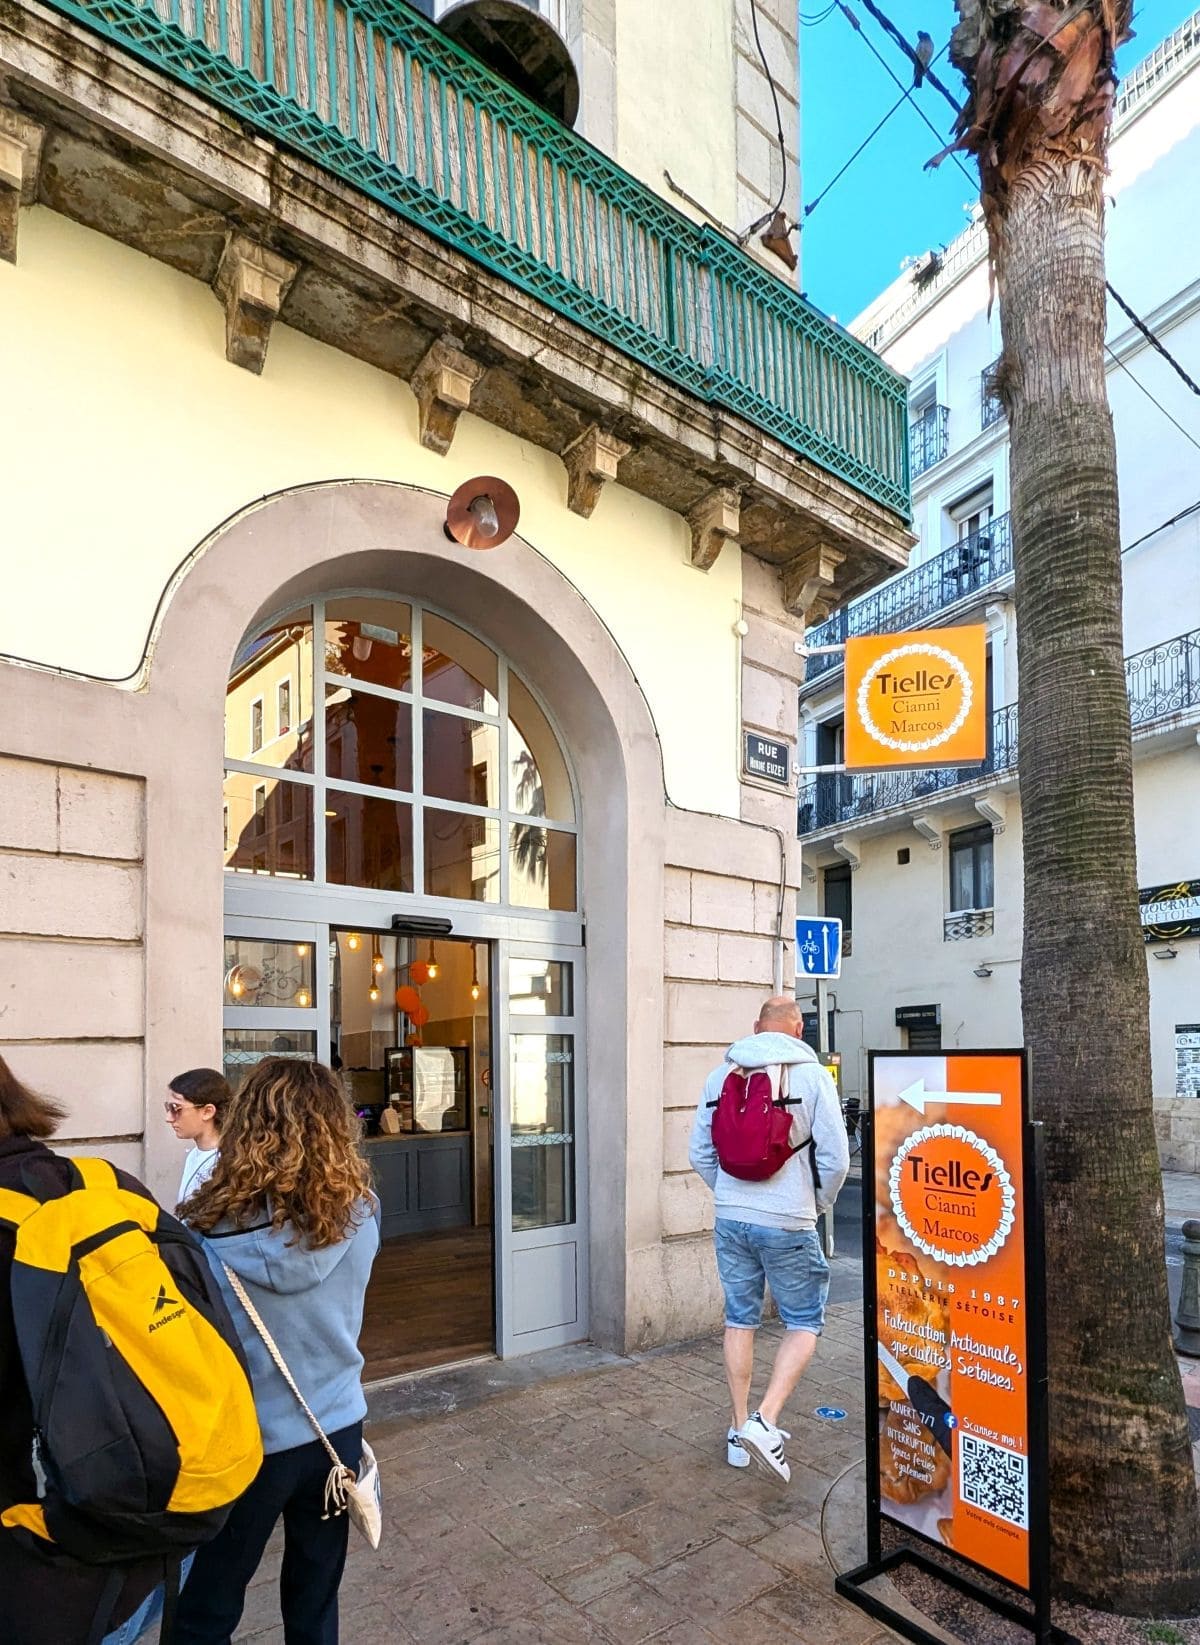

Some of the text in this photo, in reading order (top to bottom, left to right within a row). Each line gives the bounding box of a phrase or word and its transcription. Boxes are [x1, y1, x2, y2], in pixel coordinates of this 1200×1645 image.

[876, 670, 955, 694] Tielles
[893, 698, 940, 713] Cianni
[890, 719, 944, 734] Marcos
[758, 742, 777, 759] RUE
[907, 1156, 993, 1191] Tielles
[925, 1194, 976, 1217] Cianni
[922, 1218, 979, 1244] Marcos
[888, 1269, 955, 1293] DEPUIS
[889, 1284, 1014, 1324] TIELLERIE SÉTOISE
[884, 1309, 946, 1344] Fabrication
[891, 1336, 952, 1371] spécialités
[890, 1400, 935, 1427] OUVERT 7/7
[903, 1420, 921, 1436] SANS
[887, 1427, 936, 1457] INTERRUPTION
